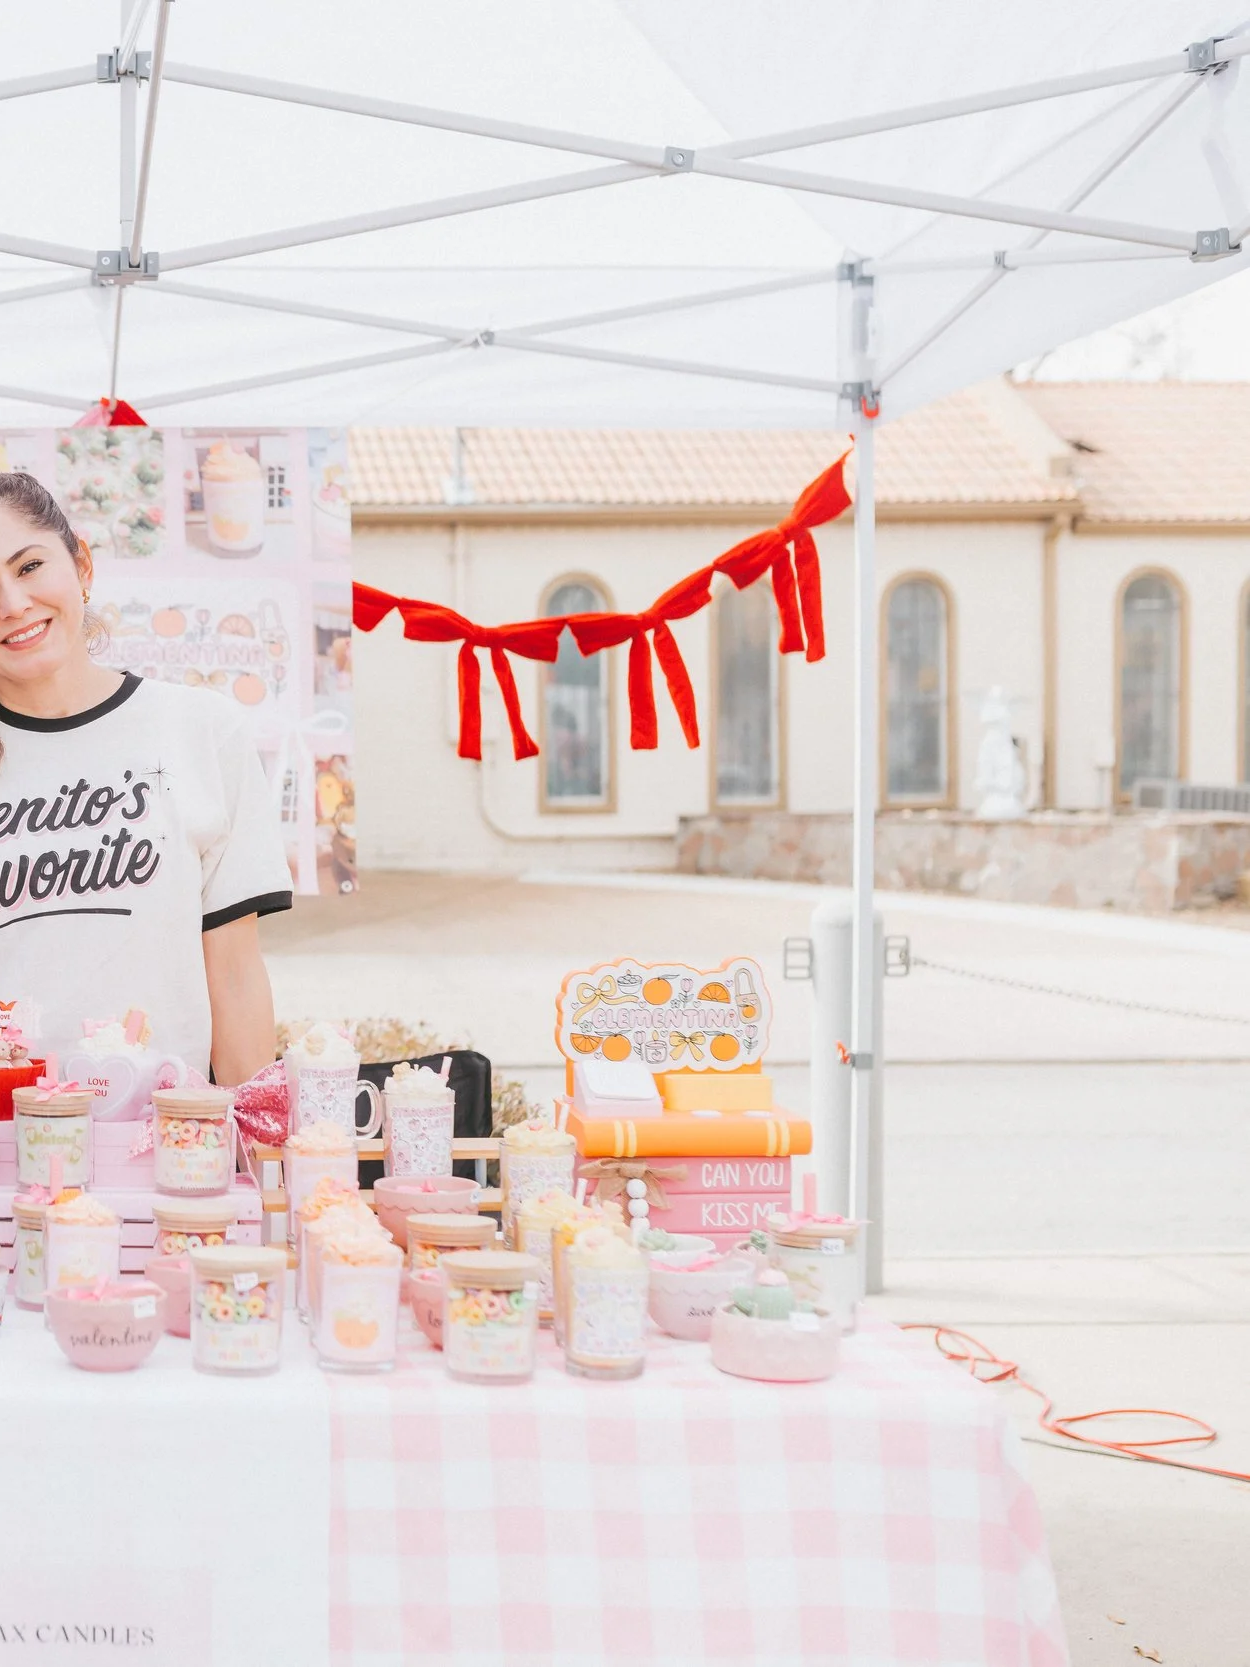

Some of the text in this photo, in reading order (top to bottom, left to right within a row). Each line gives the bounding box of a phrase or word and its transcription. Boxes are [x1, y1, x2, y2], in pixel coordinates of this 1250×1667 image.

[592, 1008, 739, 1029] CLEMENTINA
[87, 1078, 110, 1087] LOVE
[701, 1163, 784, 1188] CAN YOU
[702, 1202, 749, 1226] KISS
[34, 1624, 155, 1646] CANDLES
